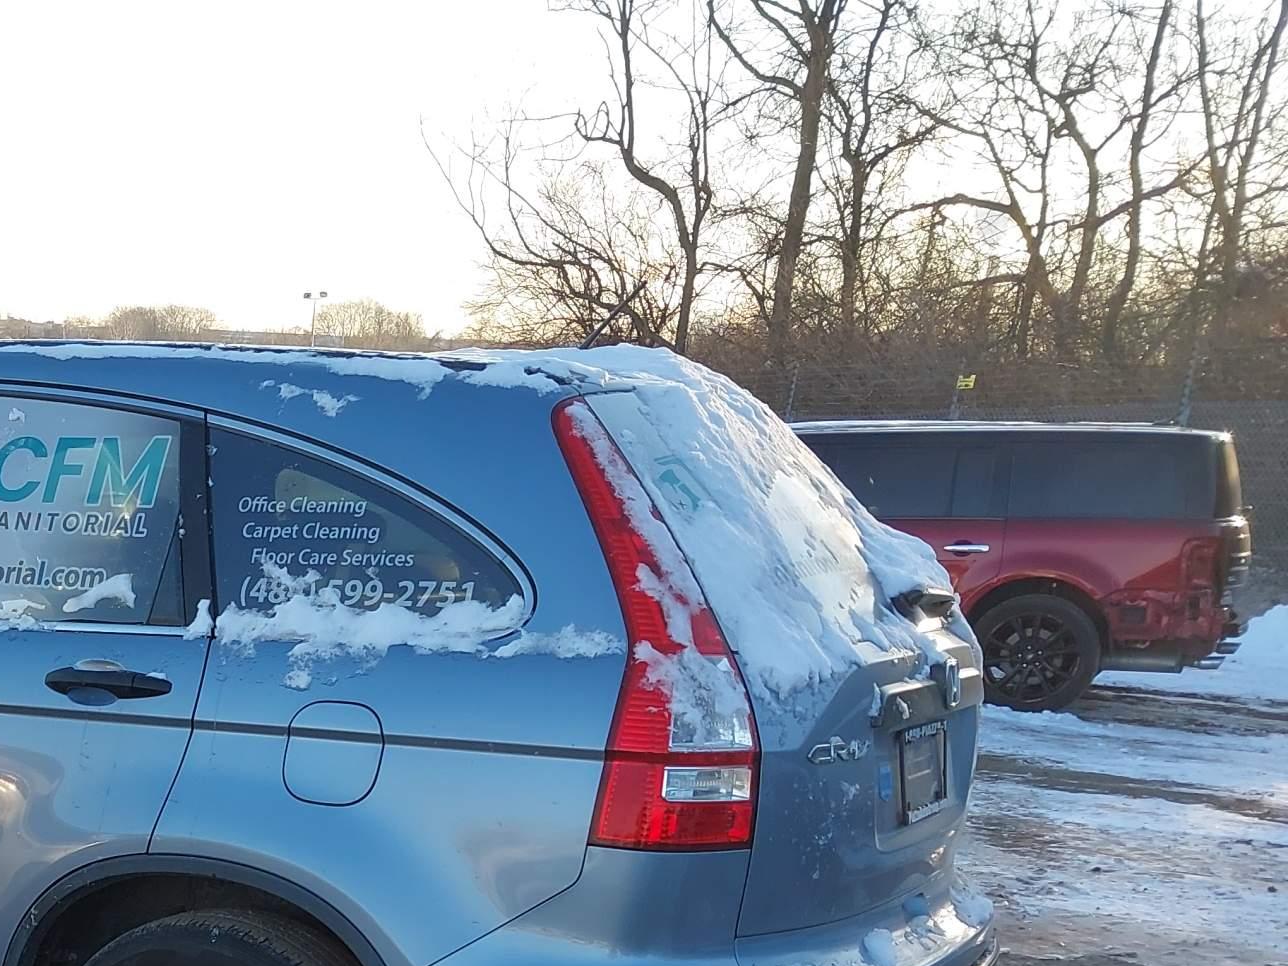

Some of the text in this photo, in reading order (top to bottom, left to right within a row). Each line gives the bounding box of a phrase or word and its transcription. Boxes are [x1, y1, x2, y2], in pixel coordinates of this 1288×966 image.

[238, 496, 368, 518] Office Cleaning
[242, 522, 381, 544] Carpet Cleaning
[250, 547, 414, 568] Floor Care Services
